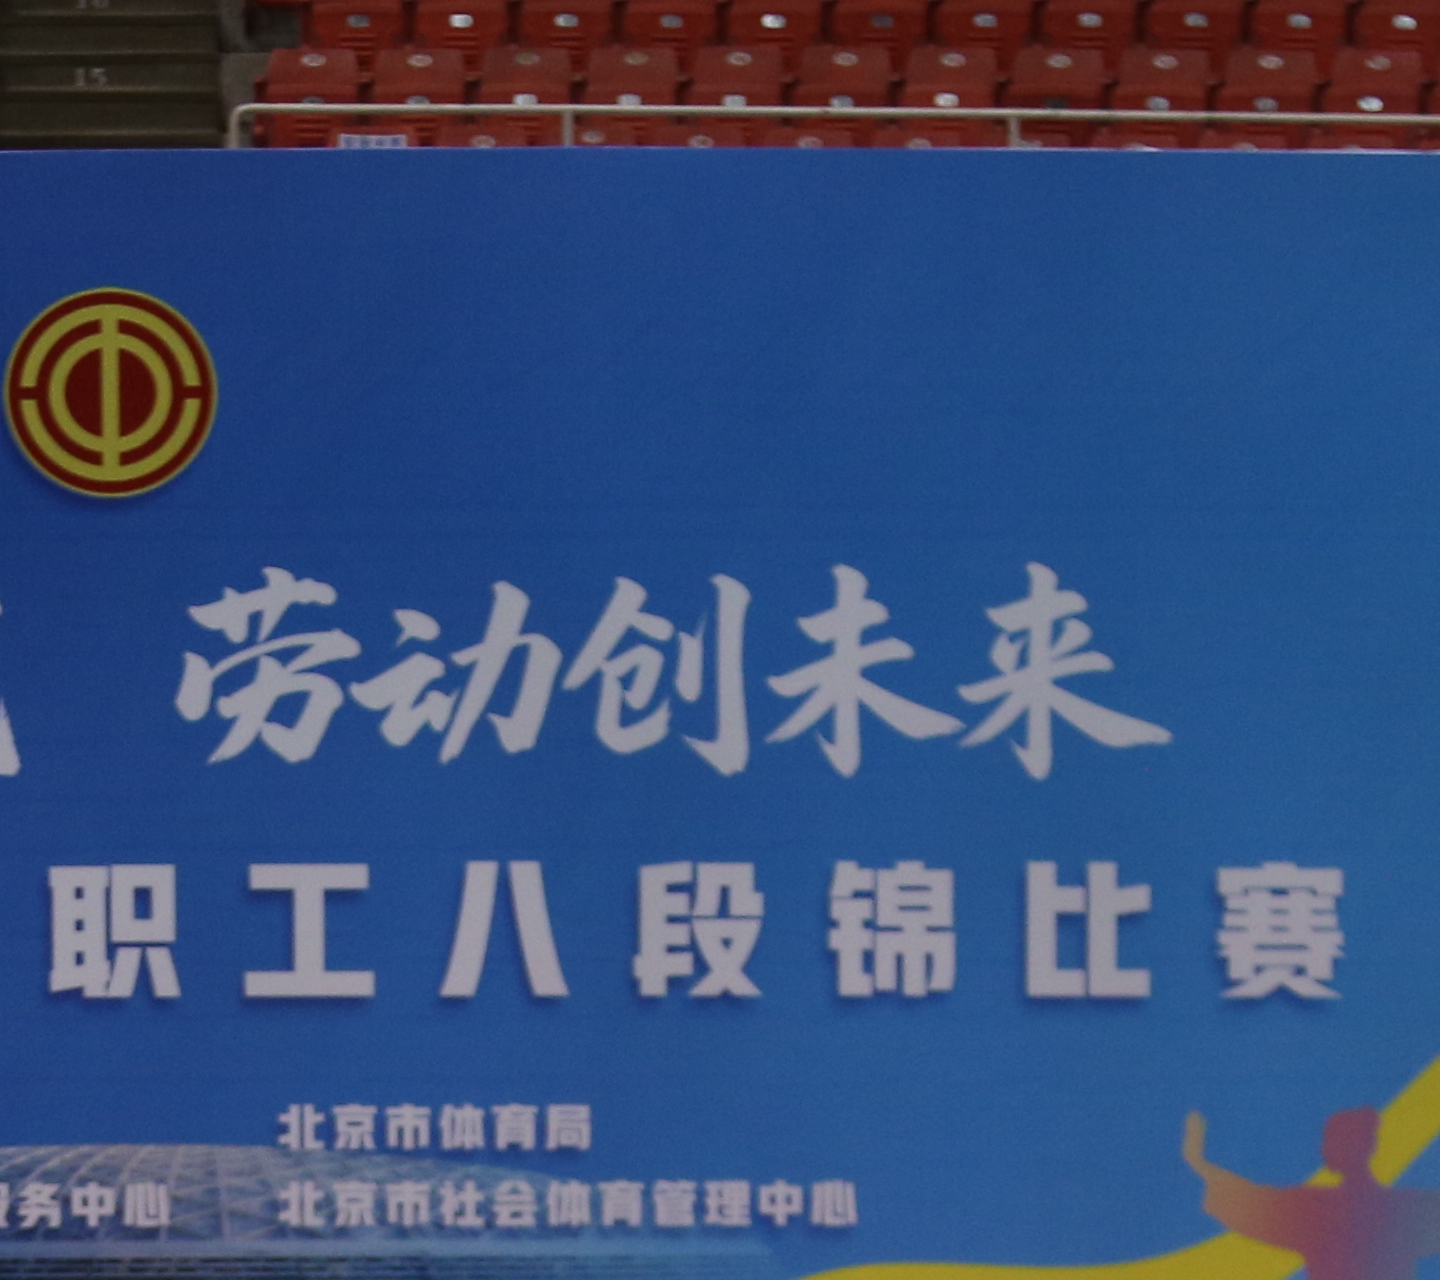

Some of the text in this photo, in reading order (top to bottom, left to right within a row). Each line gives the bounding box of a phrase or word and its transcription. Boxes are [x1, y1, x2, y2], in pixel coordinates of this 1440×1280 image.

[174, 562, 1173, 779] 劳动创未来
[279, 1104, 590, 1151] 北京市体育局
[278, 1180, 857, 1227] 北京市社会体育管理中心
